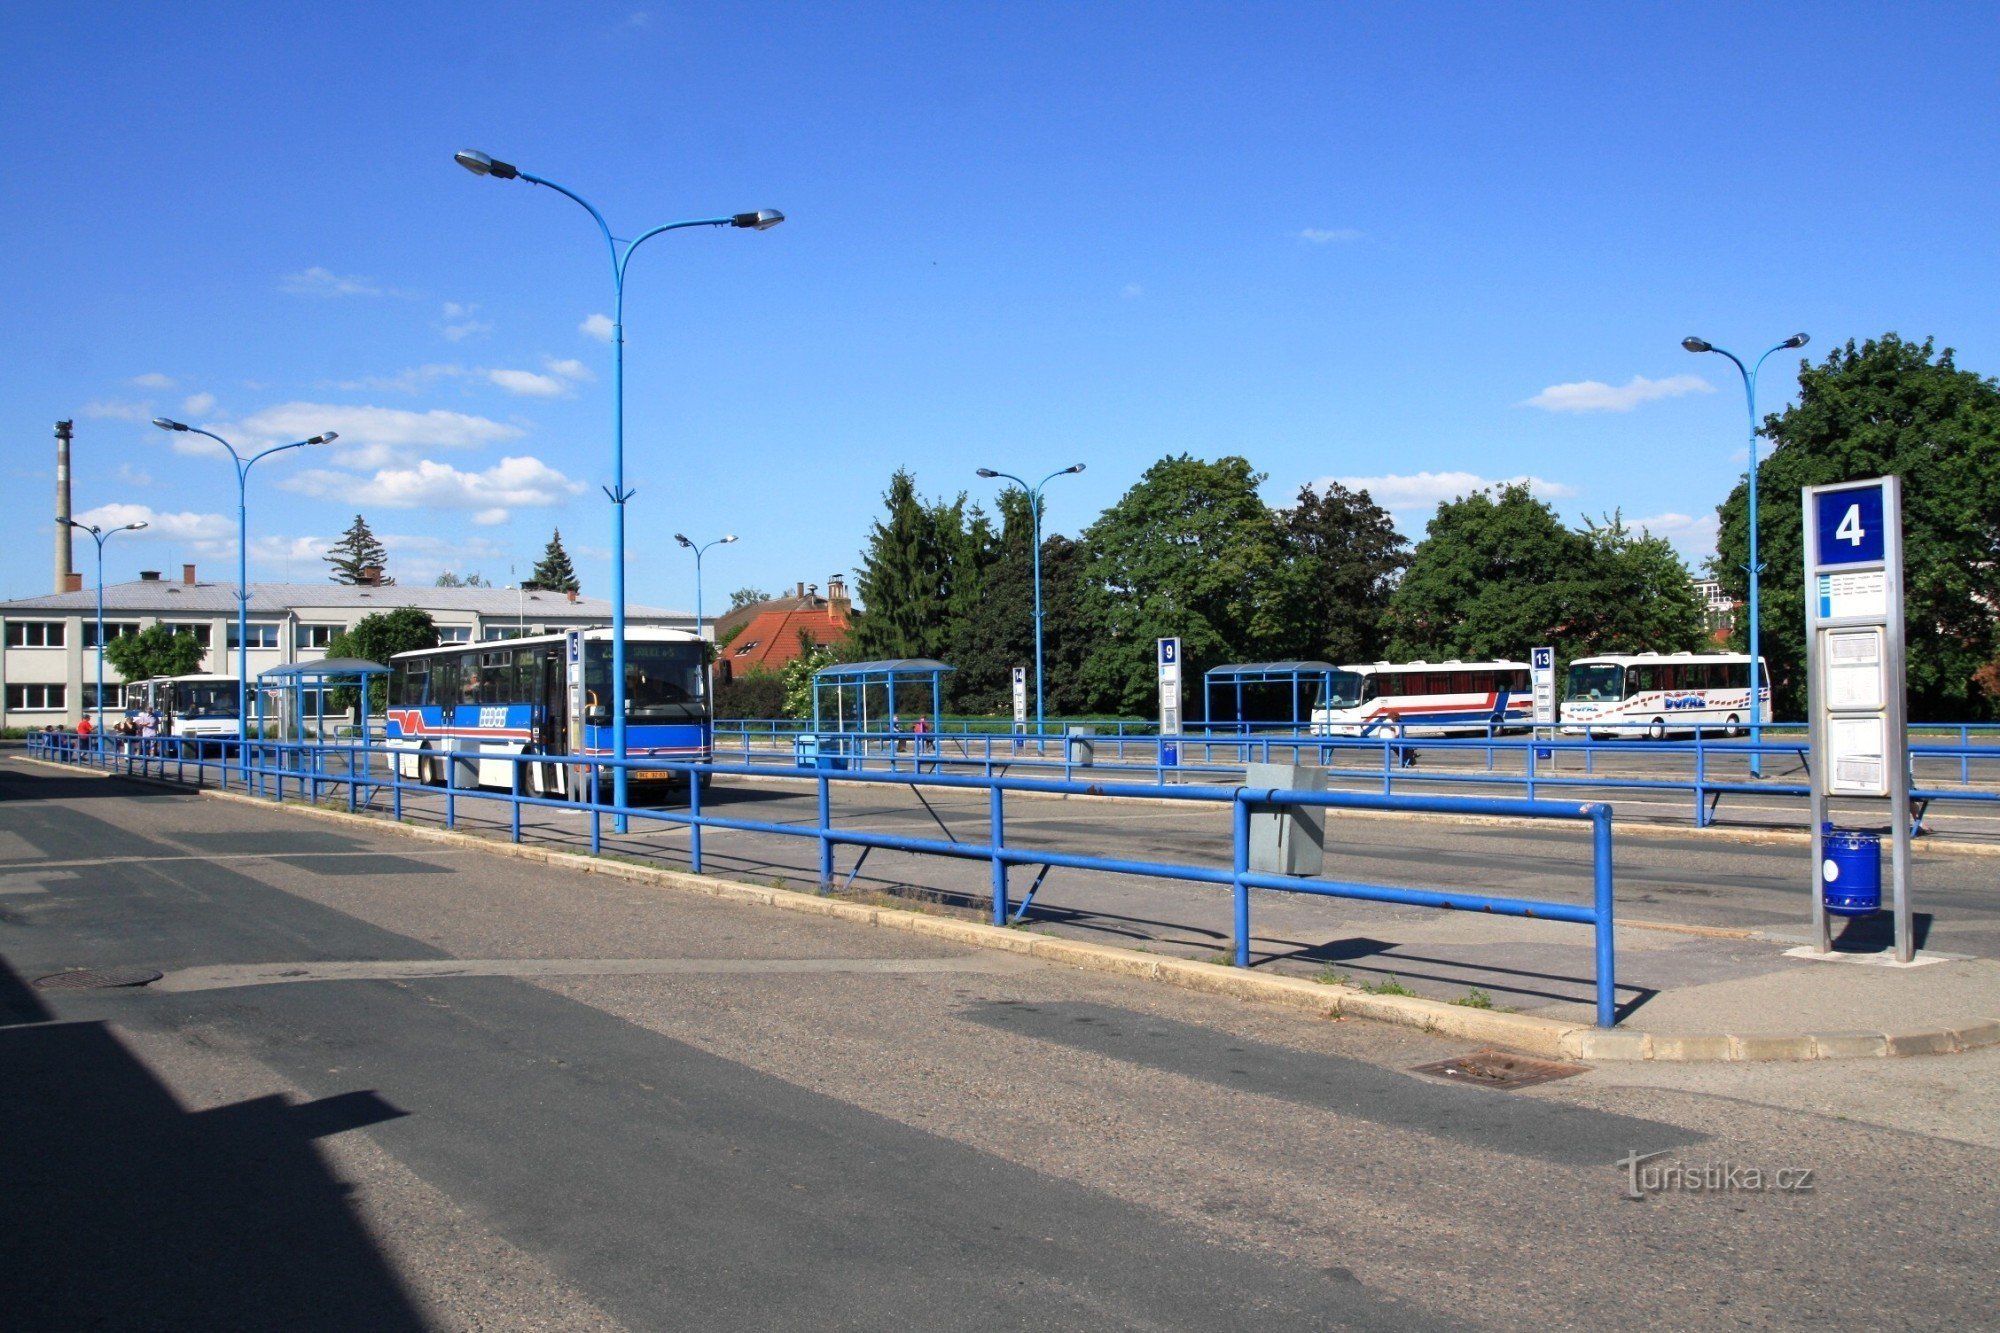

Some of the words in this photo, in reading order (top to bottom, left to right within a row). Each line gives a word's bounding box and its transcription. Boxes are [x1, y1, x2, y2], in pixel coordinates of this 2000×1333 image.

[1836, 504, 1865, 547] 4
[573, 638, 578, 655] 5
[1166, 645, 1173, 659] 9
[1536, 653, 1549, 666] 13
[1015, 671, 1023, 680] 14
